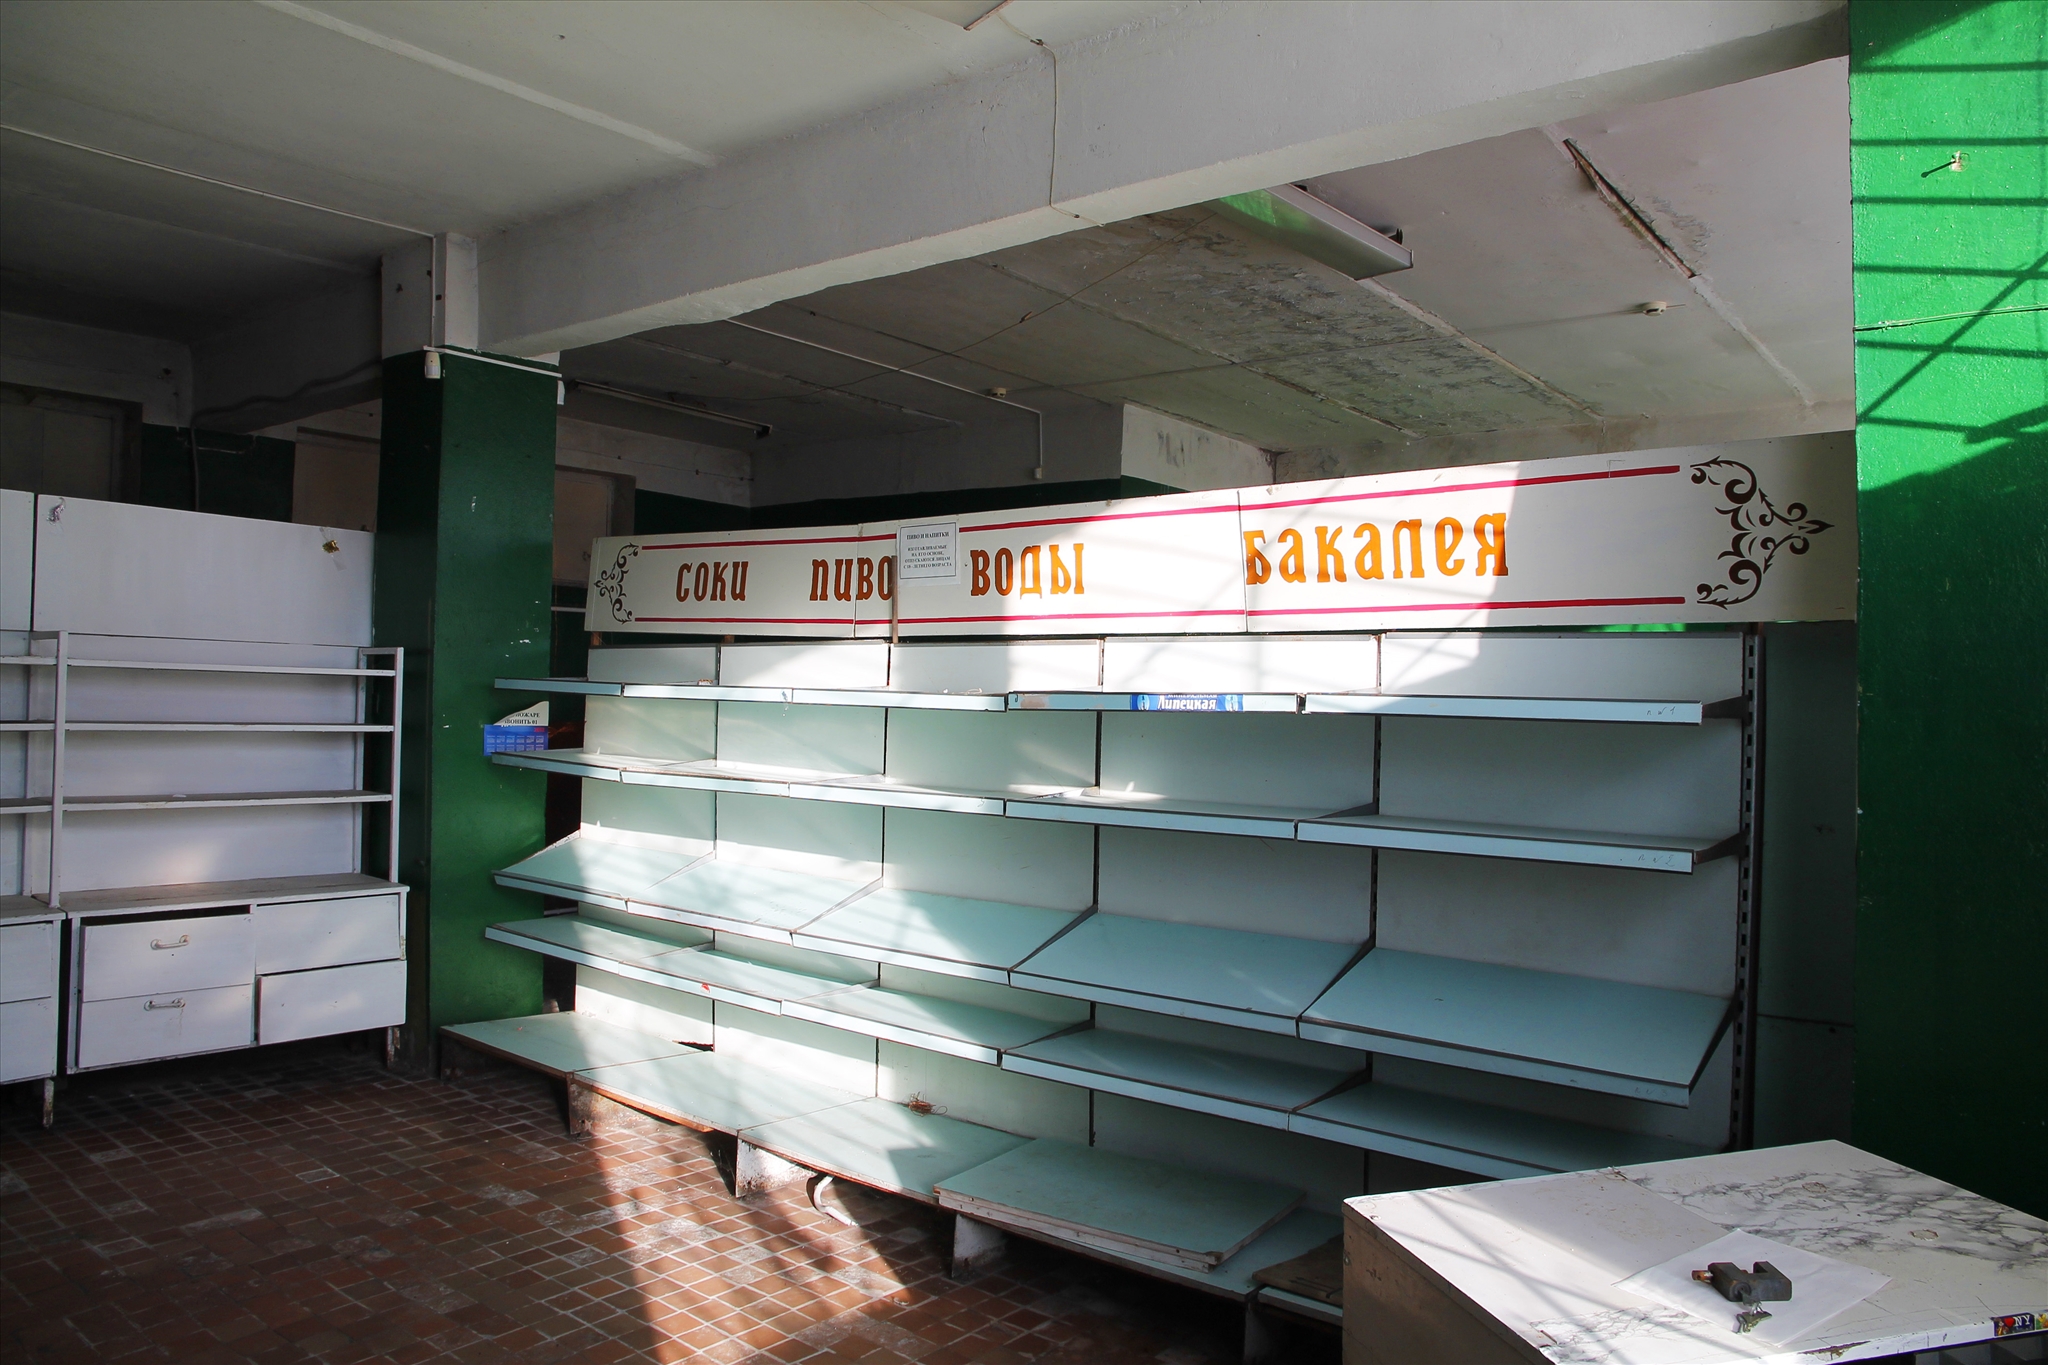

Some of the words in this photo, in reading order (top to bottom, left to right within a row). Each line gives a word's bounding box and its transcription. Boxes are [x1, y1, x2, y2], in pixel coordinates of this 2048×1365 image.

[925, 531, 950, 539] НАПИТКИ
[1157, 694, 1217, 711] Липецкая
[2012, 1314, 2031, 1327] NY
